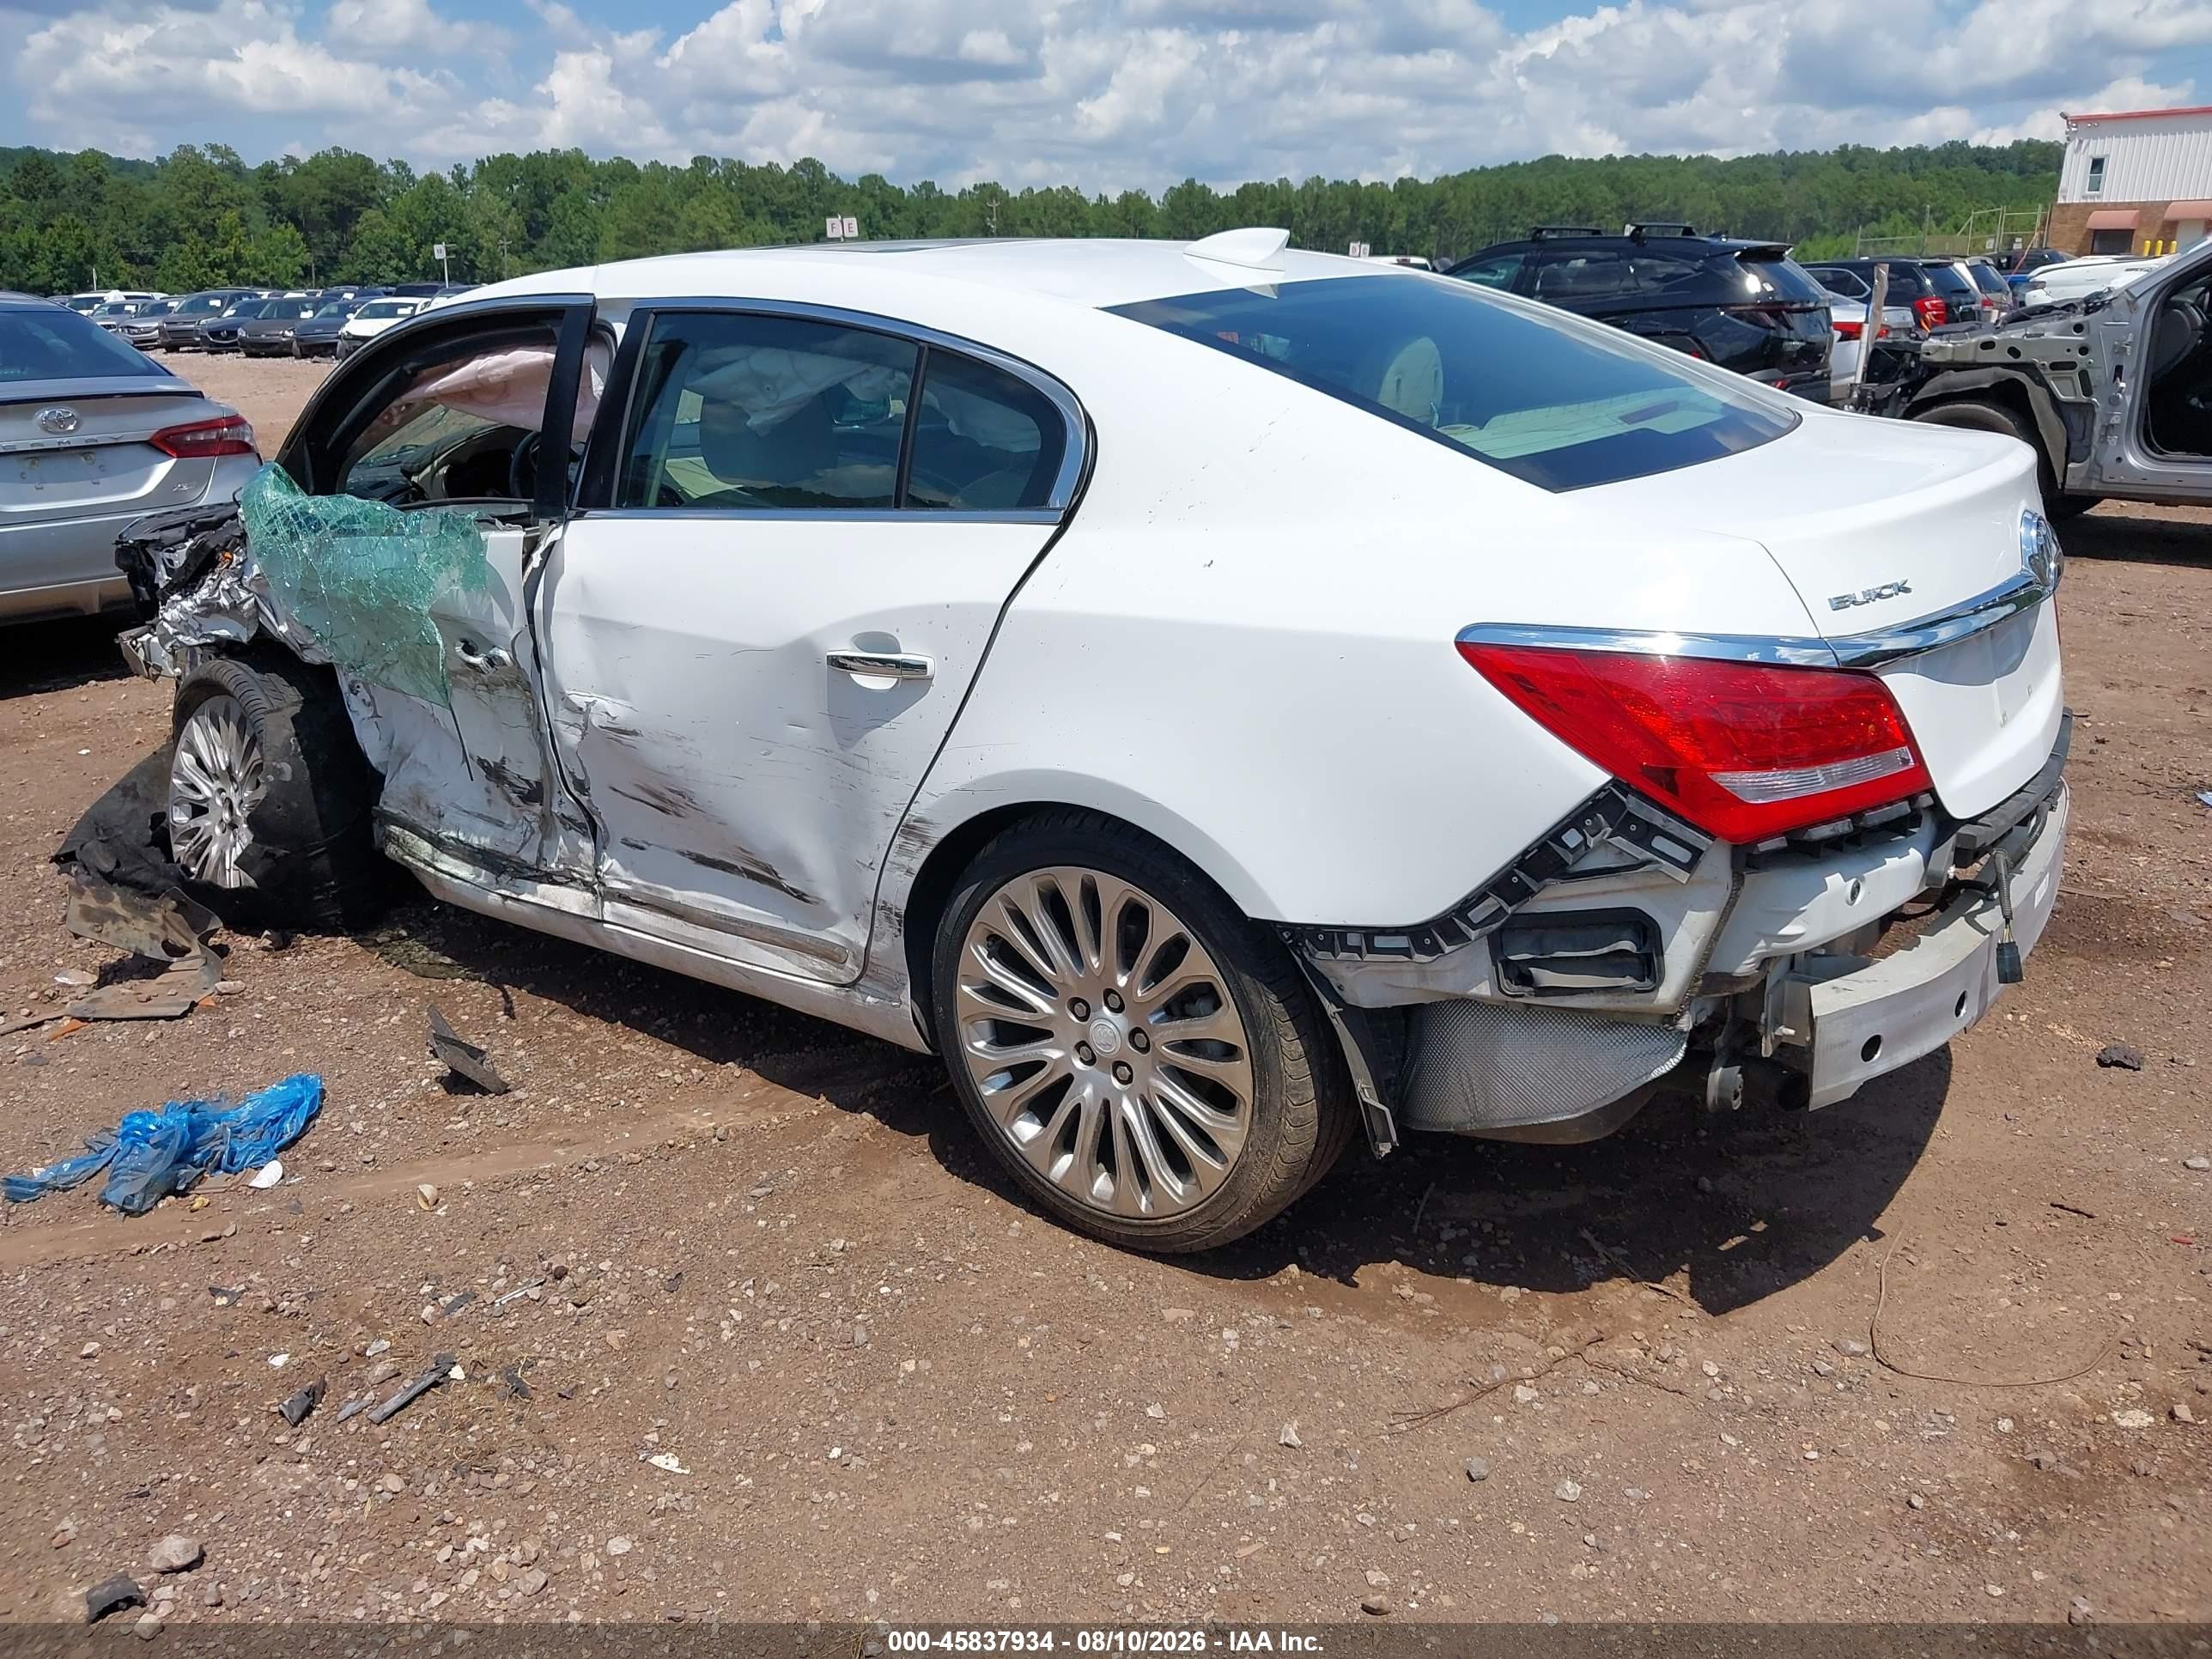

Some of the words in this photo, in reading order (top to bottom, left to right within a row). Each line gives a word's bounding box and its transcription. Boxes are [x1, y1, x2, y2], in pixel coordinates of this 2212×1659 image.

[830, 222, 837, 234] F
[848, 222, 854, 233] E
[1827, 579, 1912, 611] BUICK
